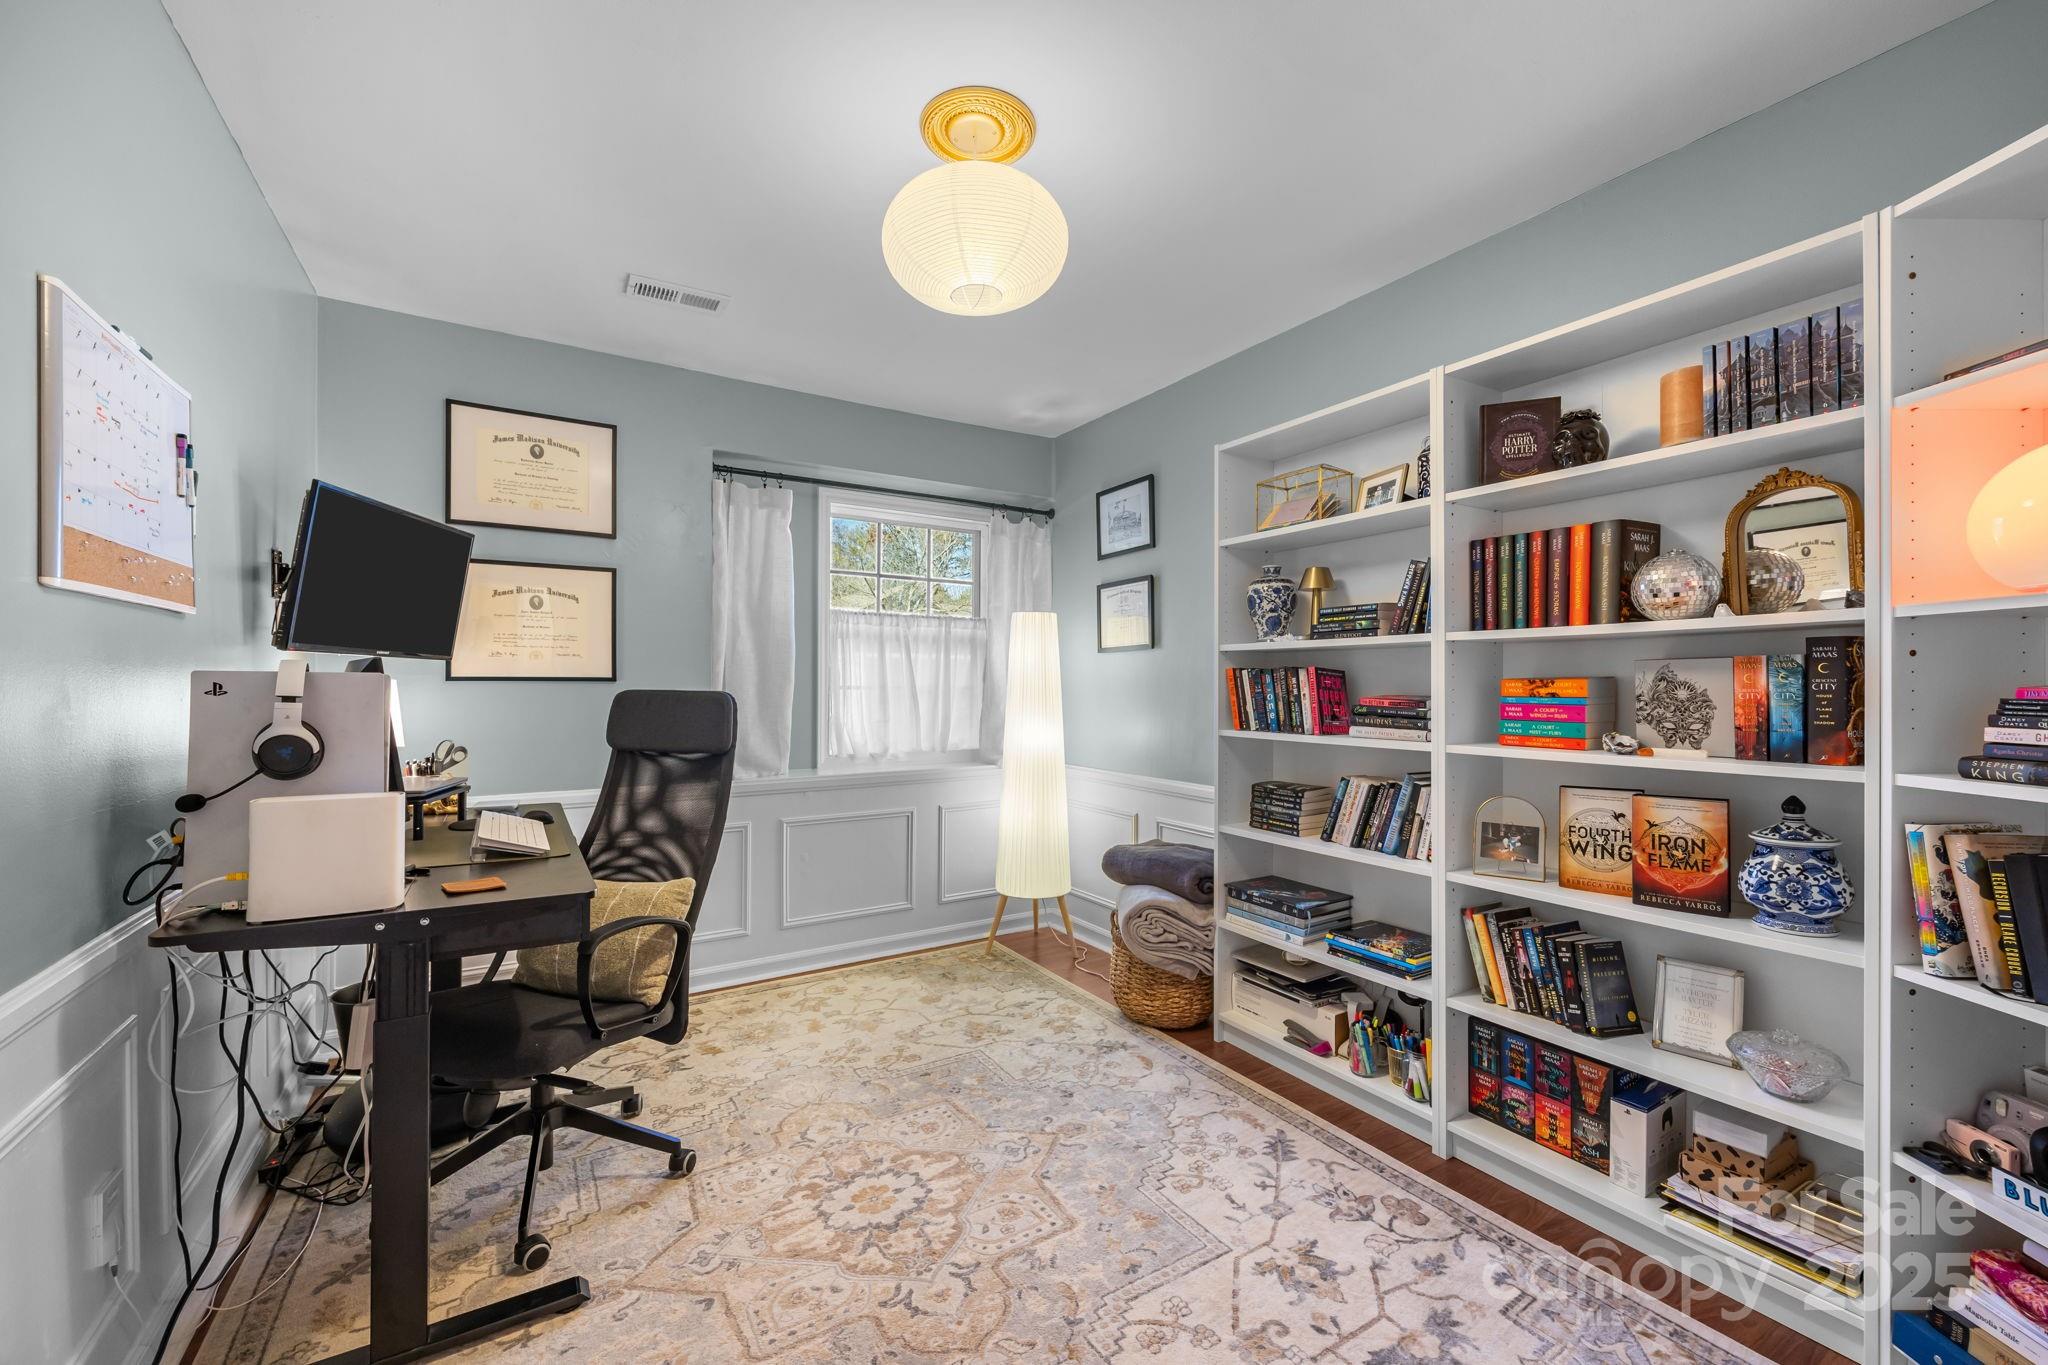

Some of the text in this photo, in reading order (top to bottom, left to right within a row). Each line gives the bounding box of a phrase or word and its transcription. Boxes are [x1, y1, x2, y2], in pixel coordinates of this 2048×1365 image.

[492, 434, 580, 458] James Madison University
[1504, 435, 1536, 446] HARRY
[1502, 443, 1538, 456] POTTER
[1630, 532, 1655, 545] SARAH J.
[1634, 543, 1650, 552] MAAS
[1398, 563, 1416, 608] STEPHEN KING
[492, 586, 580, 604] James Madison University
[1774, 660, 1798, 668] MAAS
[1812, 682, 1838, 691] CITY
[1738, 692, 1762, 700] CITY
[1774, 691, 1797, 700] CITY
[1993, 748, 2044, 757] Agatha Christie
[1972, 760, 2025, 770] STEPHEN
[1970, 768, 2025, 783] KING
[1568, 826, 1632, 844] FOURTH
[1568, 838, 1632, 862] WING
[1651, 834, 1706, 856] IRON
[1648, 852, 1712, 874] FLAME
[1566, 878, 1602, 888] REBECCA
[1606, 882, 1632, 891] YARRO
[1640, 894, 1682, 907] REBECCA
[1685, 898, 1722, 912] YARROS
[1992, 872, 2022, 976] RECURSION BLAKE CROUCH
[1528, 938, 1536, 956] FOUND
[1552, 990, 1560, 1014] MIDNIGHT
[1475, 1025, 1490, 1035] SARAH
[1478, 1032, 1492, 1040] MAAS
[1507, 1037, 1524, 1047] SARAH
[1510, 1043, 1525, 1052] MAAS
[1505, 1049, 1530, 1064] THRONE
[1541, 1050, 1558, 1060] SARAH
[1544, 1056, 1560, 1066] MAAS
[1508, 1062, 1528, 1074] GLASS
[1540, 1064, 1566, 1078] CROWN
[1578, 1063, 1598, 1074] SARAH
[1476, 1072, 1491, 1083] SARAH
[1582, 1070, 1598, 1080] MAAS
[1478, 1078, 1492, 1088] MAAS
[1536, 1075, 1568, 1093] MIDNIGHT
[1580, 1080, 1600, 1092] HEIR
[1507, 1098, 1528, 1112] EMPIRE
[1542, 1100, 1560, 1112] SARAH
[1582, 1094, 1599, 1106] FIRE
[1545, 1107, 1560, 1116] MAAS
[1506, 1110, 1530, 1126] STORMS
[1540, 1113, 1565, 1129] TOWER
[1579, 1115, 1598, 1126] SARAH
[1582, 1122, 1599, 1132] MAAS
[1542, 1126, 1564, 1144] DAWN
[1582, 1145, 1600, 1158] ASH
[1964, 1304, 1998, 1332] Magnolia
[1999, 1327, 2020, 1344] Table
